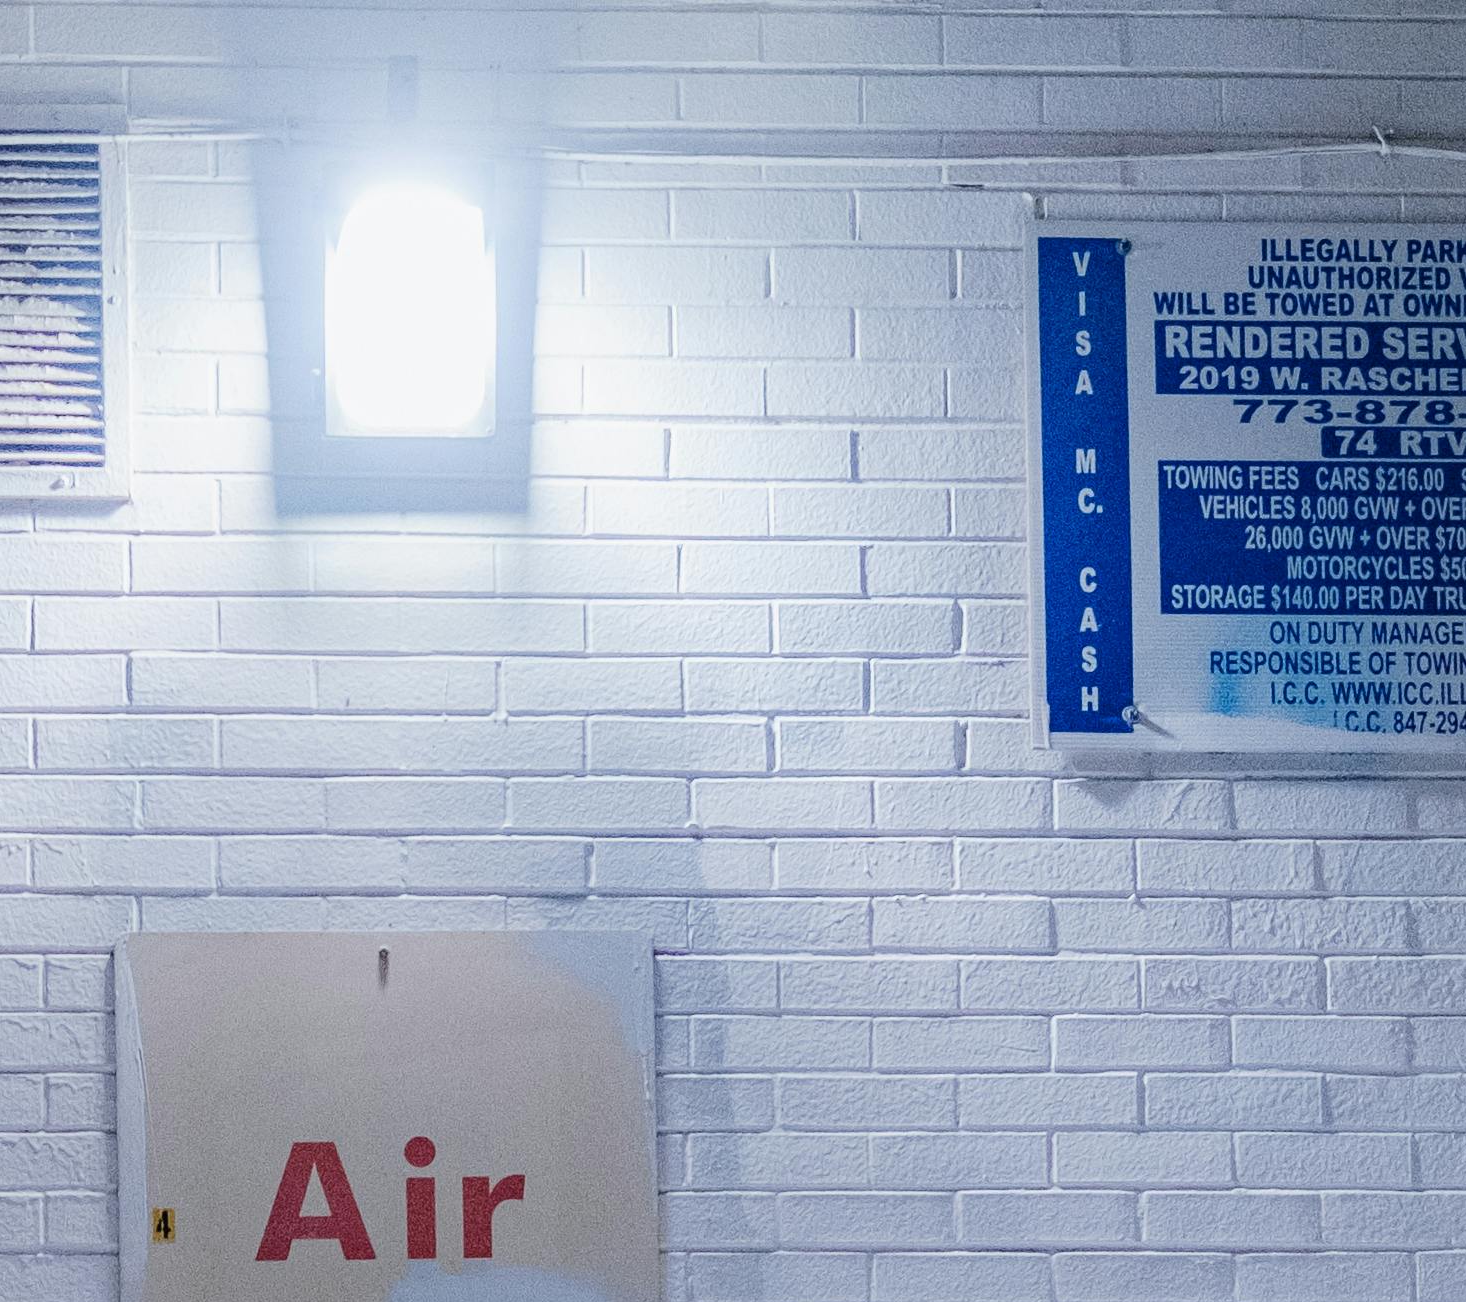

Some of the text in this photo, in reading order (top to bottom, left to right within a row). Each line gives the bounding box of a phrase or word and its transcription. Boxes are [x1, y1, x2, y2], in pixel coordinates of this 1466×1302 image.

[1261, 238, 1398, 262] ILLEGALLY
[1248, 265, 1451, 290] UNAUTHORIZED
[1153, 292, 1214, 315] WILL
[1224, 292, 1257, 315] BE
[1265, 293, 1354, 316] TOWED
[1364, 294, 1394, 316] AT
[1072, 251, 1094, 395] VISA
[1165, 325, 1370, 359] RENDERED
[1179, 365, 1260, 390] 2019
[1270, 366, 1309, 390] W.
[1335, 430, 1377, 456] 74
[1163, 465, 1242, 489] TOWING
[1249, 467, 1299, 490] FEES
[1316, 467, 1370, 491] CARS
[1376, 466, 1444, 493] $216.00
[1200, 495, 1295, 519] VEHICLES
[1301, 496, 1348, 523] 8,000
[1354, 497, 1398, 520] GVW
[1405, 501, 1416, 516] +
[1245, 525, 1303, 553] 26,000
[1309, 526, 1354, 549] GVW
[1359, 531, 1371, 545] +
[1376, 526, 1429, 550] OVER
[1287, 555, 1434, 580] MOTORCYCLES
[1171, 584, 1265, 609] STORAGE
[1271, 584, 1339, 612] $140.00
[1345, 586, 1384, 610] PER
[1390, 586, 1428, 610] DAY
[1079, 566, 1100, 712] CASH
[1270, 621, 1300, 644] ON
[1308, 621, 1364, 645] DUTY
[1210, 651, 1361, 675] RESPONSIBLE
[1368, 652, 1396, 675] OF
[1271, 681, 1325, 704] I.C.C.
[255, 1136, 526, 1261] Air
[156, 1210, 171, 1238] 4
